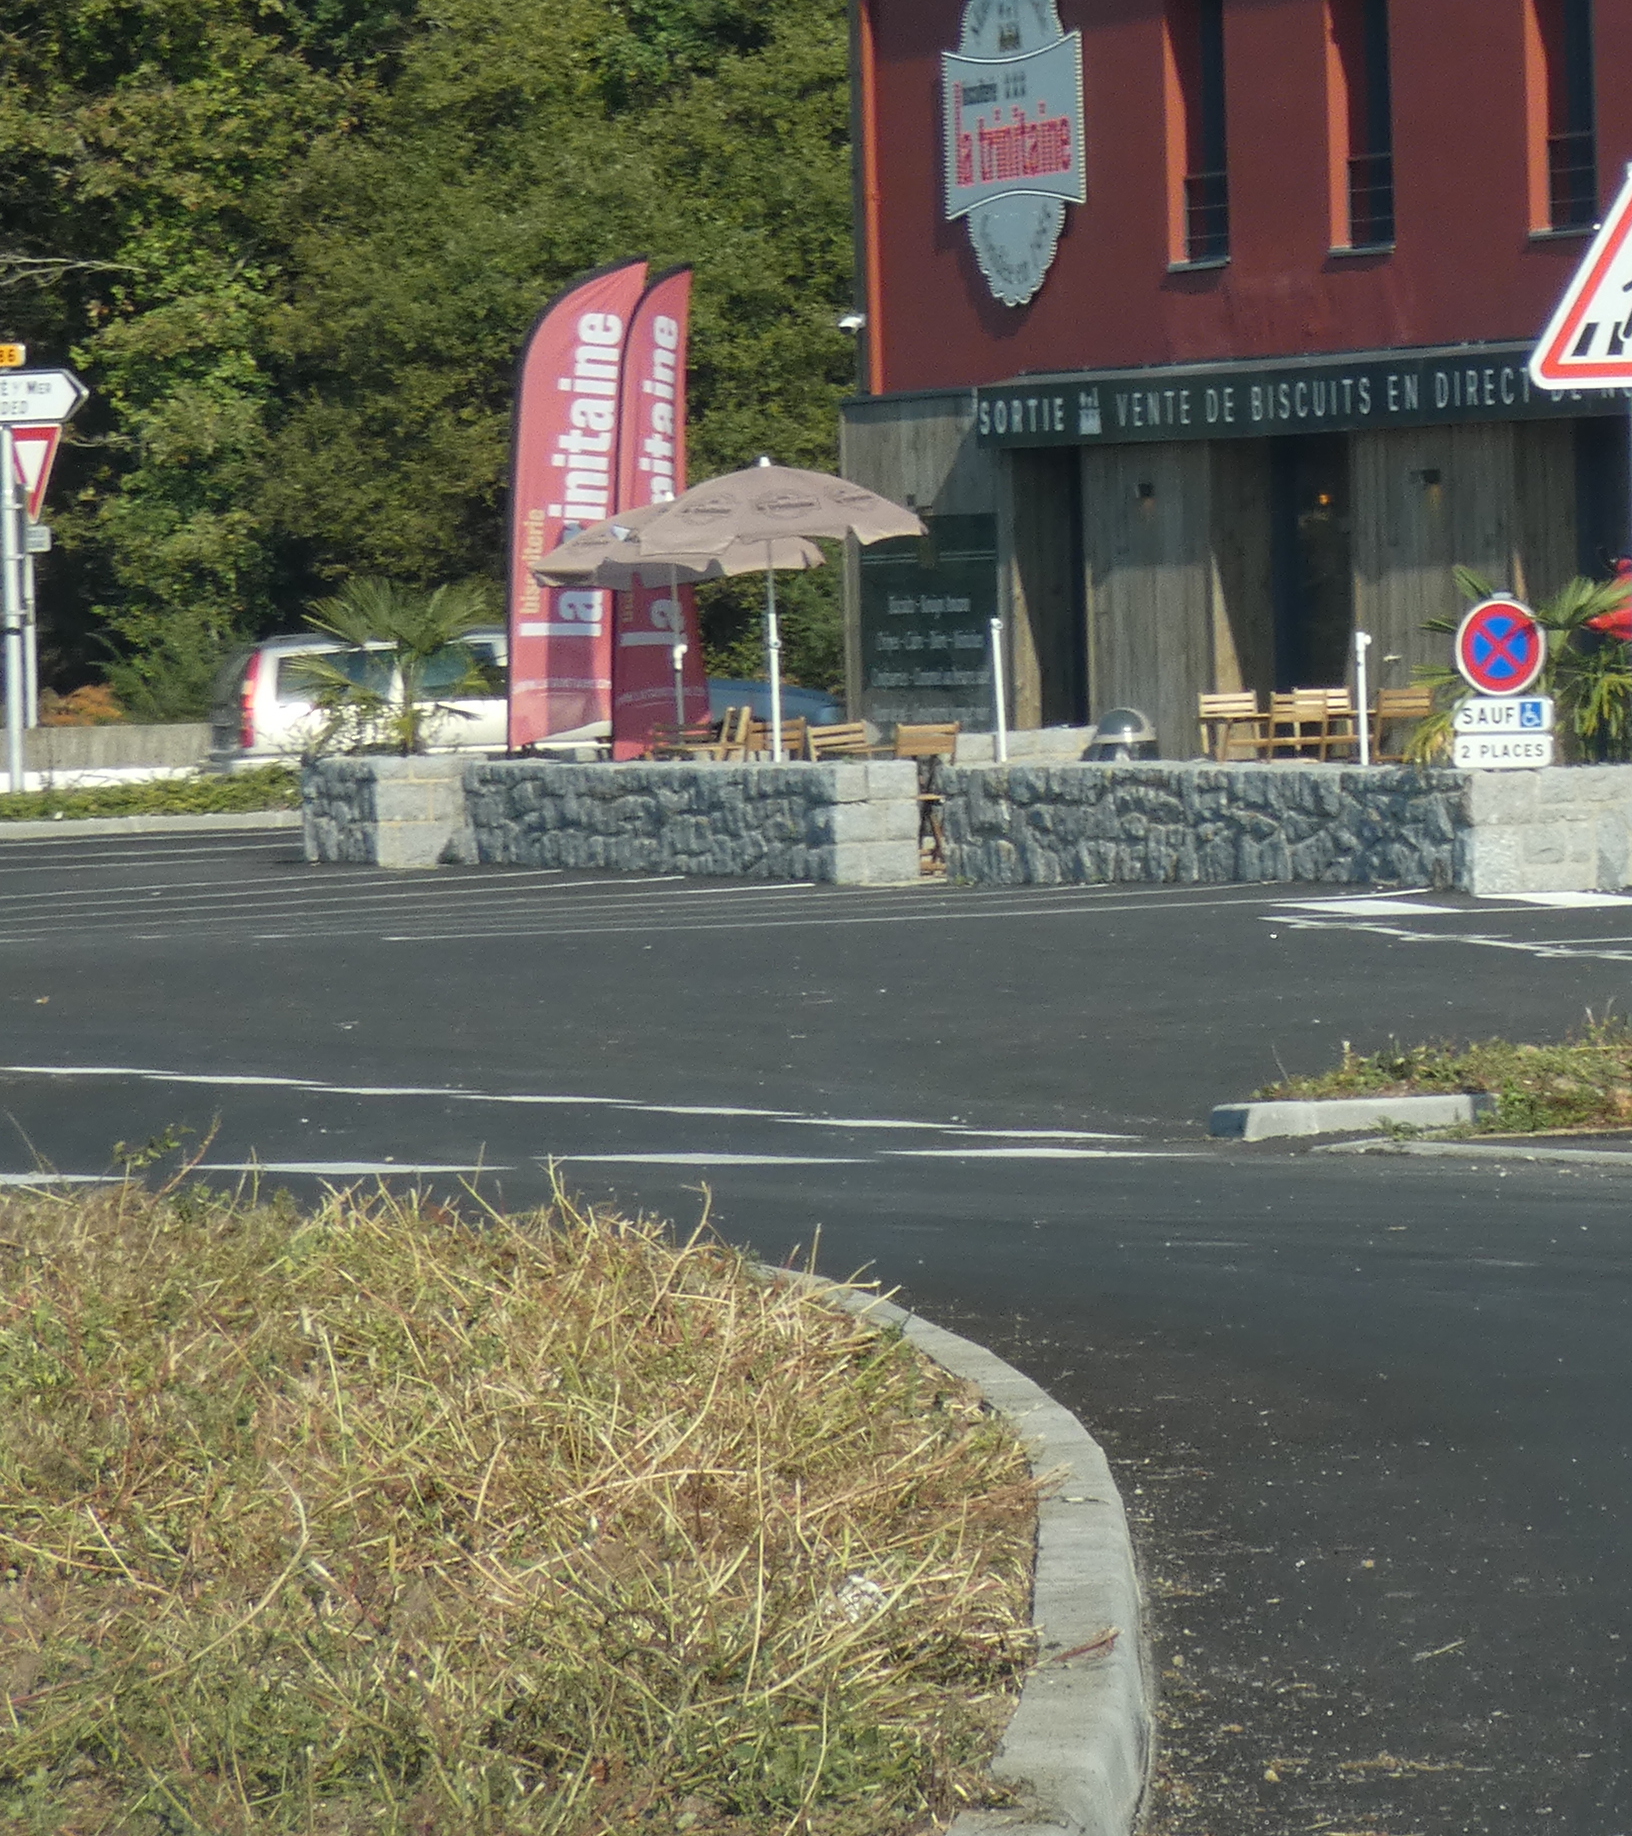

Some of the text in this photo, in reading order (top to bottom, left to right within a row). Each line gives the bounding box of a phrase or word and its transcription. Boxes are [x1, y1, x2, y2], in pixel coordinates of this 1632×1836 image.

[953, 79, 1071, 188] la trinitaine
[977, 397, 1065, 436] SORTIE
[1115, 367, 1531, 428] VENTE DE BISCUITS EN DIRECT
[519, 591, 603, 637] la
[1462, 707, 1515, 724] SAUF
[1461, 743, 1545, 759] 2 PLACES
